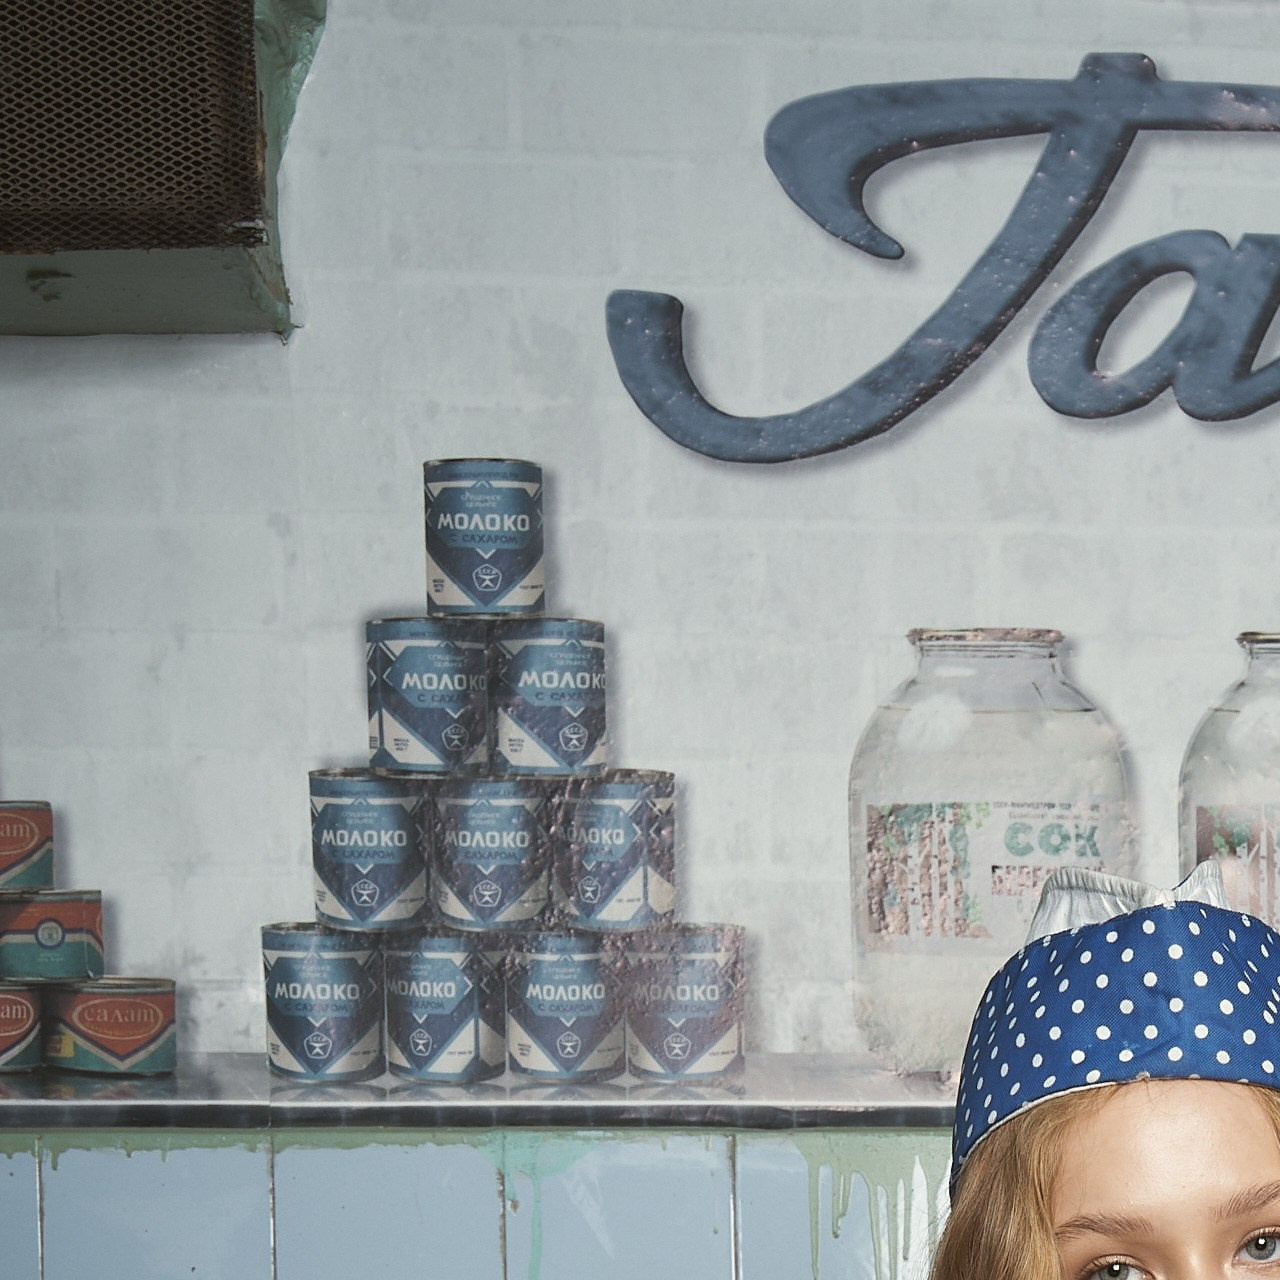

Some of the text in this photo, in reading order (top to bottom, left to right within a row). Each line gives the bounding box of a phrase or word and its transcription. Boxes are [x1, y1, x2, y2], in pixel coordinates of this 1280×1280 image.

[437, 513, 530, 531] МОЛОКО
[402, 672, 487, 691] МОЛОКО
[321, 830, 408, 848] МОЛОКО
[444, 830, 530, 848] МОЛОКО
[1004, 821, 1100, 857] СОК
[275, 982, 360, 1000] МОЛОКО
[526, 983, 606, 1000] МОЛОКО
